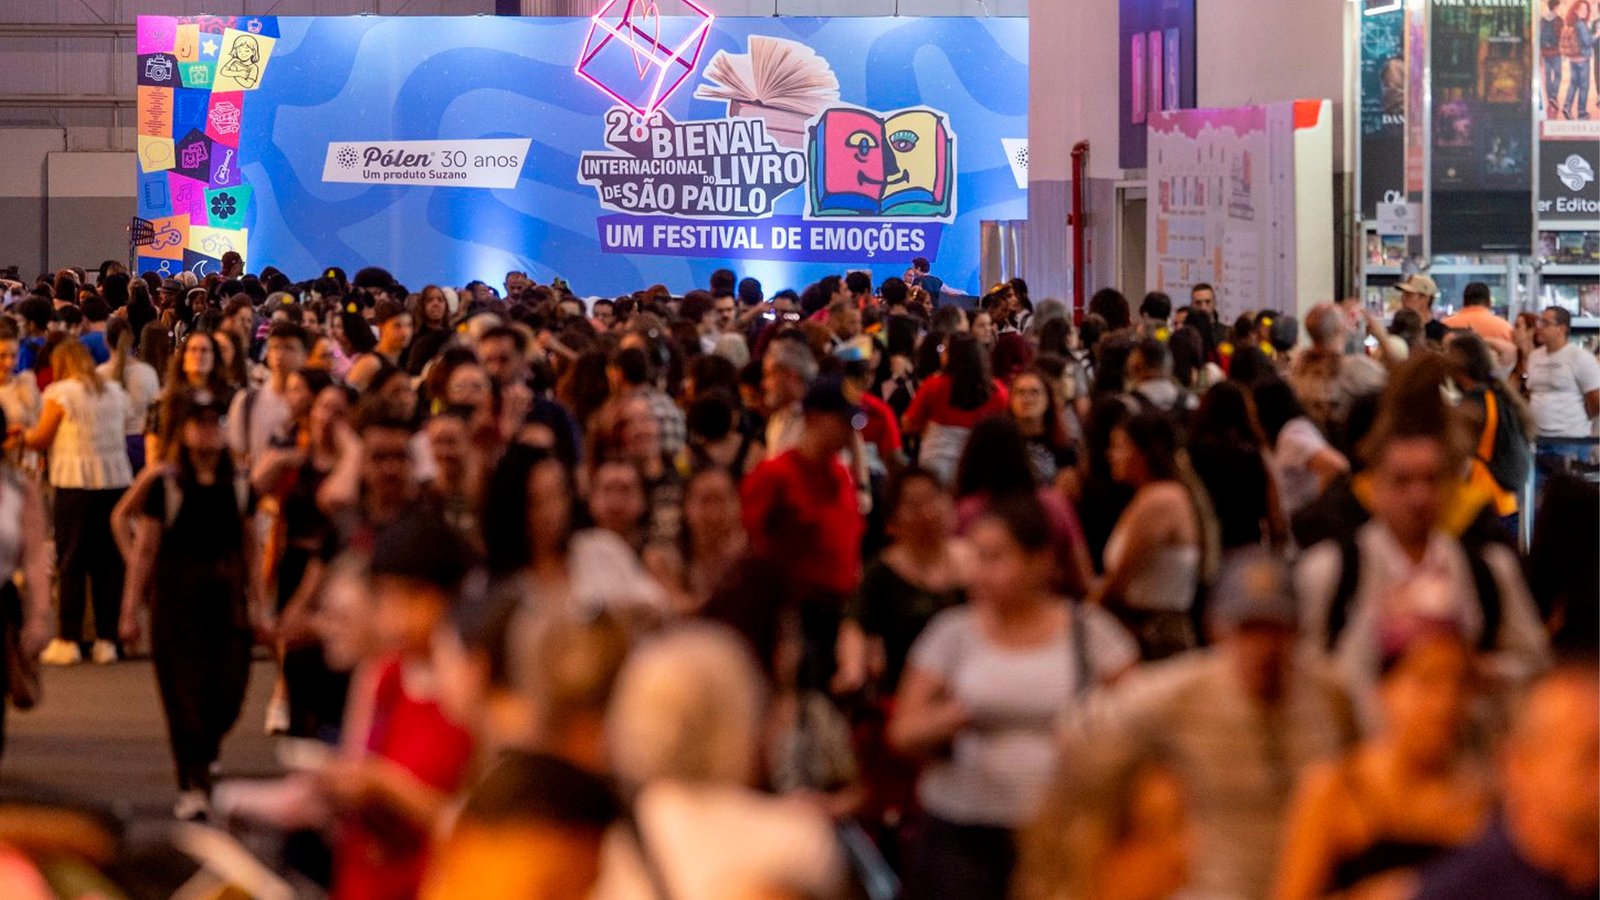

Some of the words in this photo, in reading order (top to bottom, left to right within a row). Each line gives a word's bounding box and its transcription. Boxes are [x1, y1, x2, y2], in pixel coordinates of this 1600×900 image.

[652, 121, 772, 158] BIENAL
[441, 150, 467, 168] 30
[474, 155, 518, 168] anos
[584, 160, 707, 175] INTERNACIONAL
[703, 174, 715, 184] DO
[713, 153, 805, 185] LIVRO
[363, 170, 381, 179] Um
[384, 170, 426, 181] produto
[429, 170, 467, 179] Suzano
[604, 185, 622, 200] DE
[621, 178, 675, 210] SÃO
[682, 186, 766, 212] PAULO
[606, 225, 644, 247] UM
[653, 225, 764, 249] FESTIVAL
[771, 227, 802, 249] DE
[810, 223, 926, 256] EMOÇÕES
